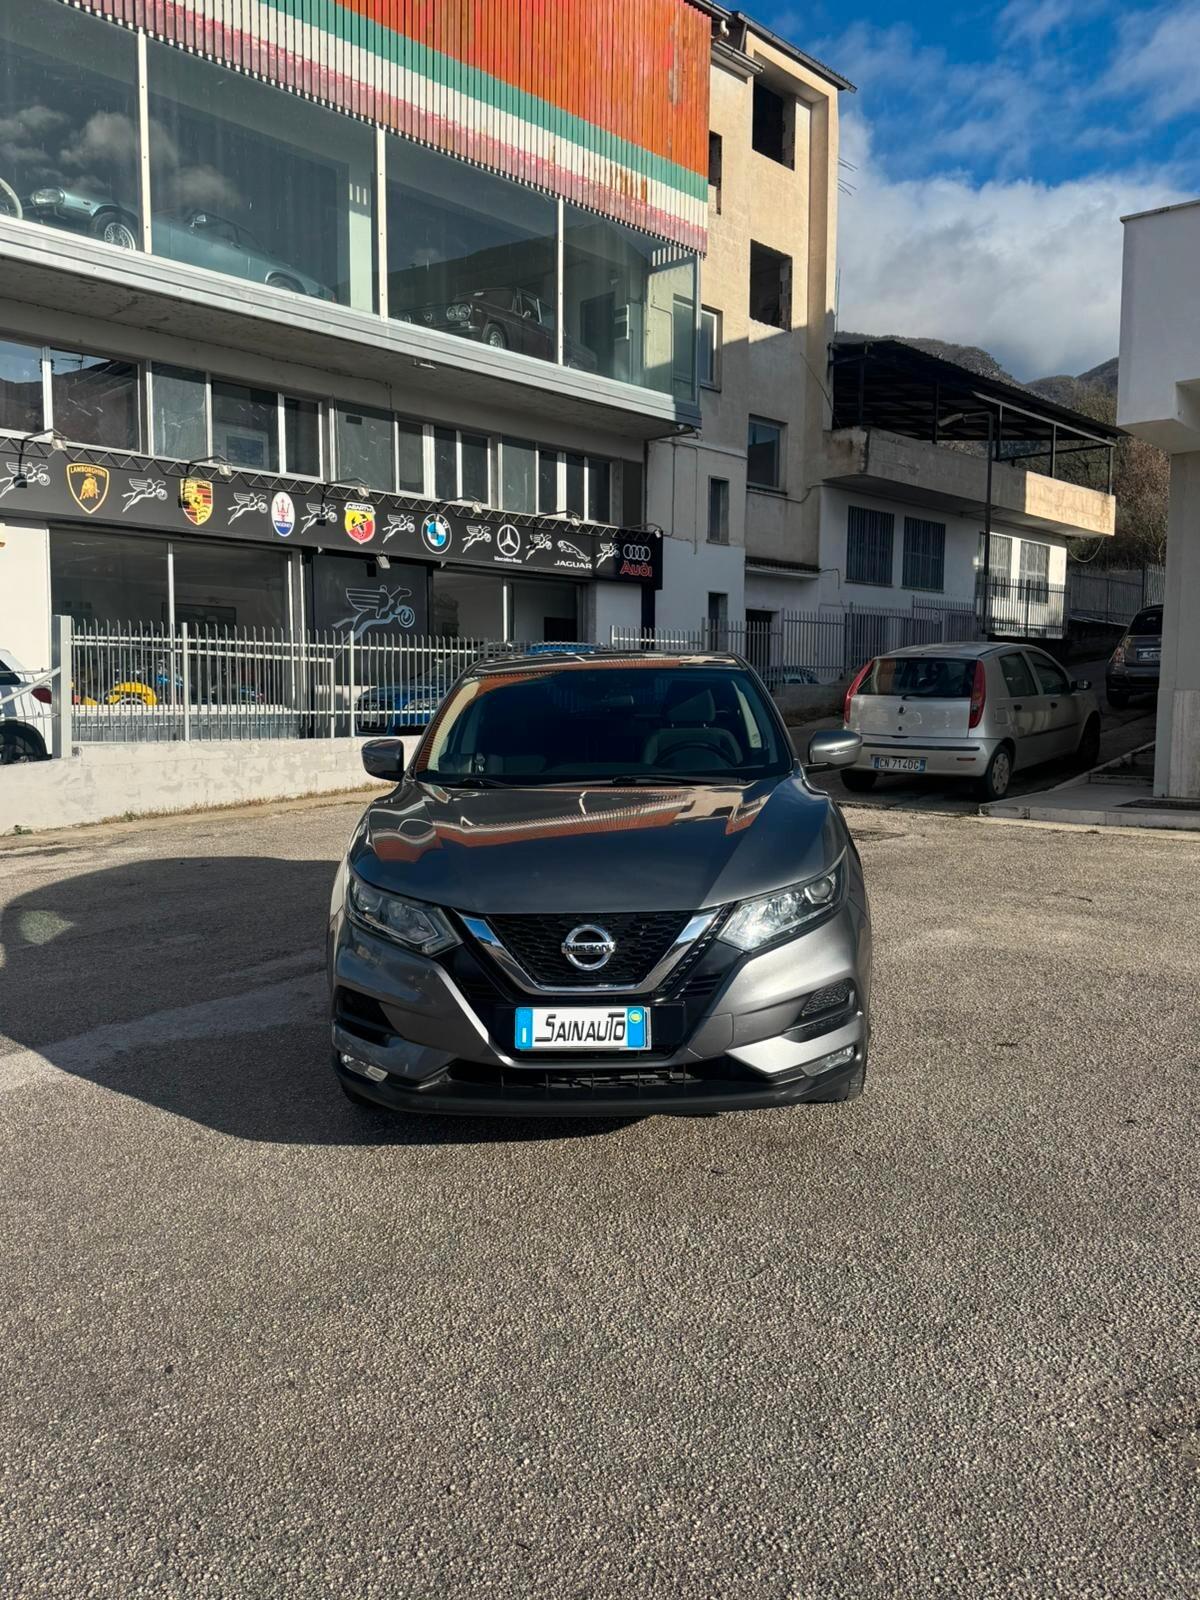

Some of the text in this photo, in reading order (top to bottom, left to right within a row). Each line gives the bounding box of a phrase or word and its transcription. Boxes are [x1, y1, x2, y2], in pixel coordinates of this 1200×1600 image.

[554, 560, 592, 569] JAGUAR
[880, 758, 890, 768] CN
[566, 944, 610, 953] NISSAN
